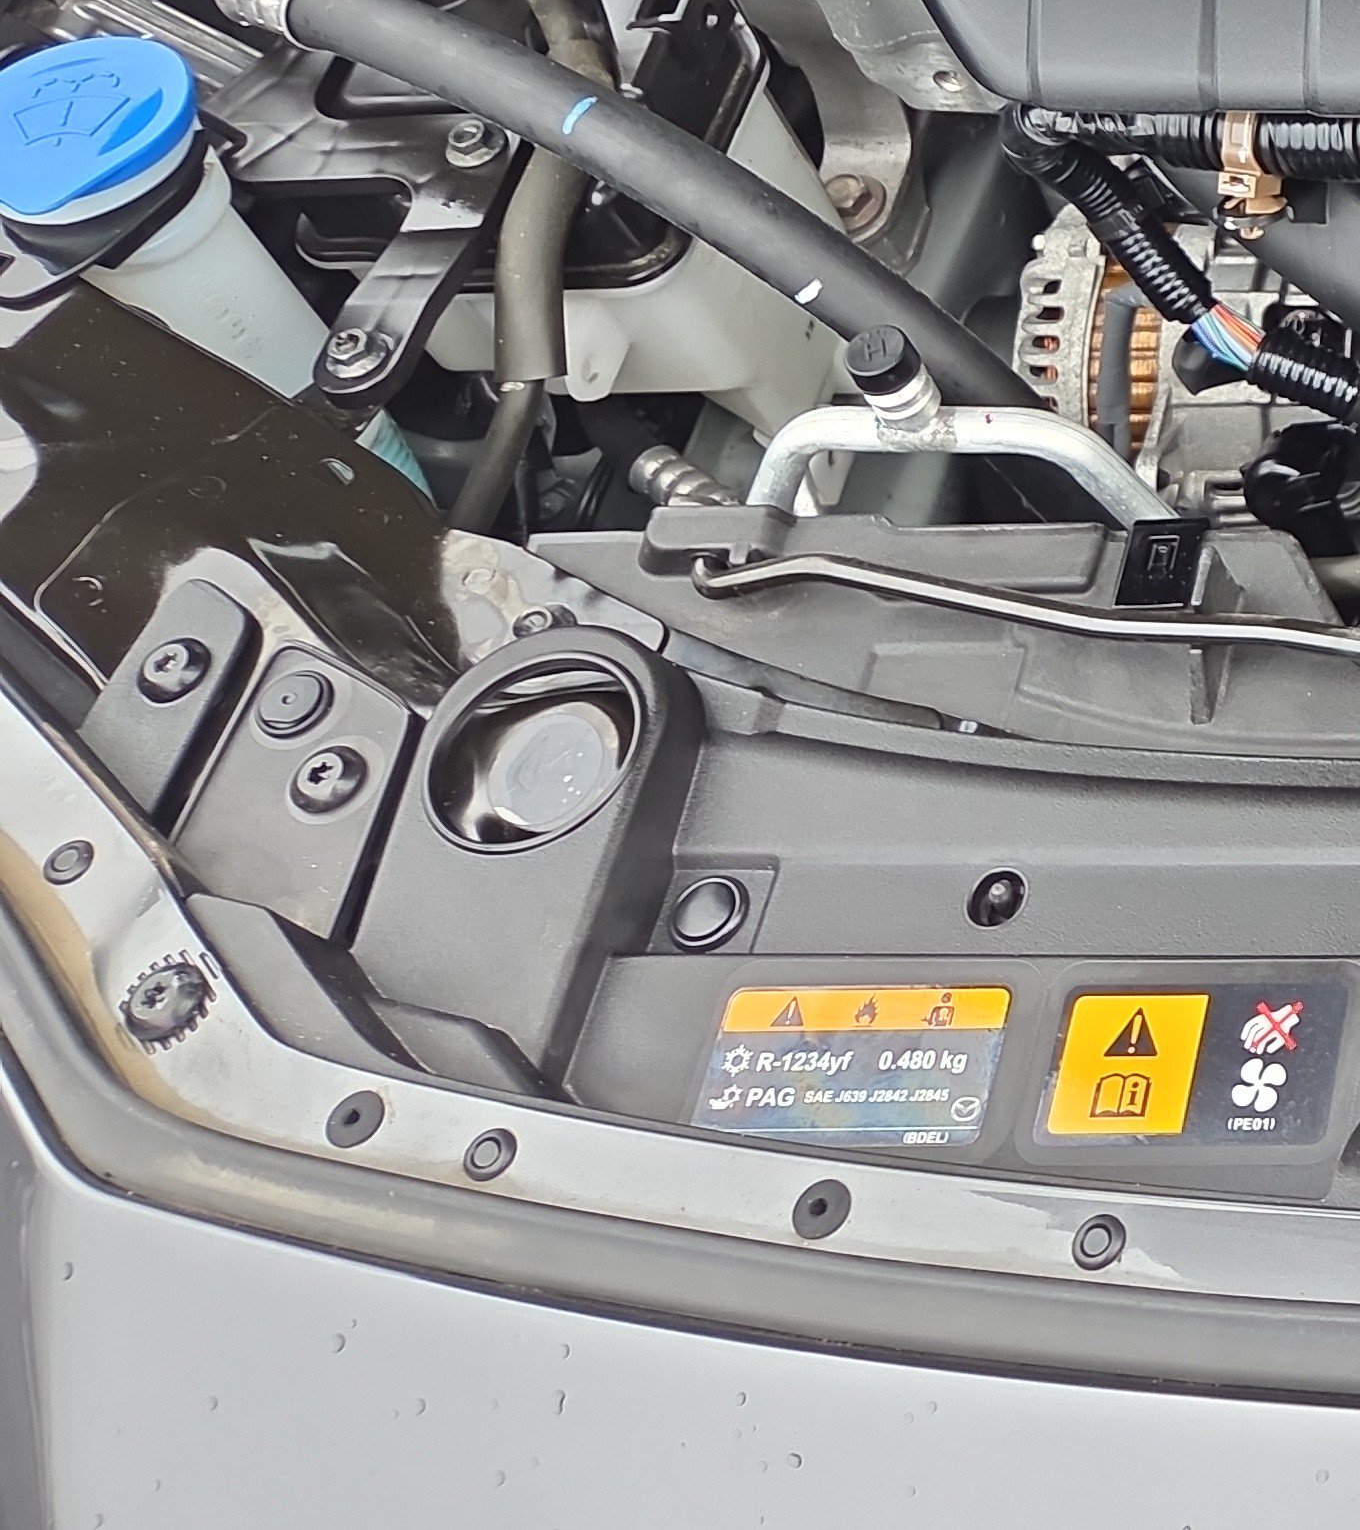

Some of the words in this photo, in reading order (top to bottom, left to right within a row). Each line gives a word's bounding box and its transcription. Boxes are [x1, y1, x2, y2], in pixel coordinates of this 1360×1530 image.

[755, 1050, 854, 1076] R-1234yf
[878, 1050, 936, 1071] 0.480
[939, 1049, 968, 1074] kg
[745, 1086, 796, 1107] PAG
[803, 1090, 834, 1104] SAE
[834, 1089, 867, 1103] J639
[868, 1088, 908, 1103] J2842
[909, 1088, 950, 1103] J2845
[1226, 1118, 1276, 1133] (PE01)
